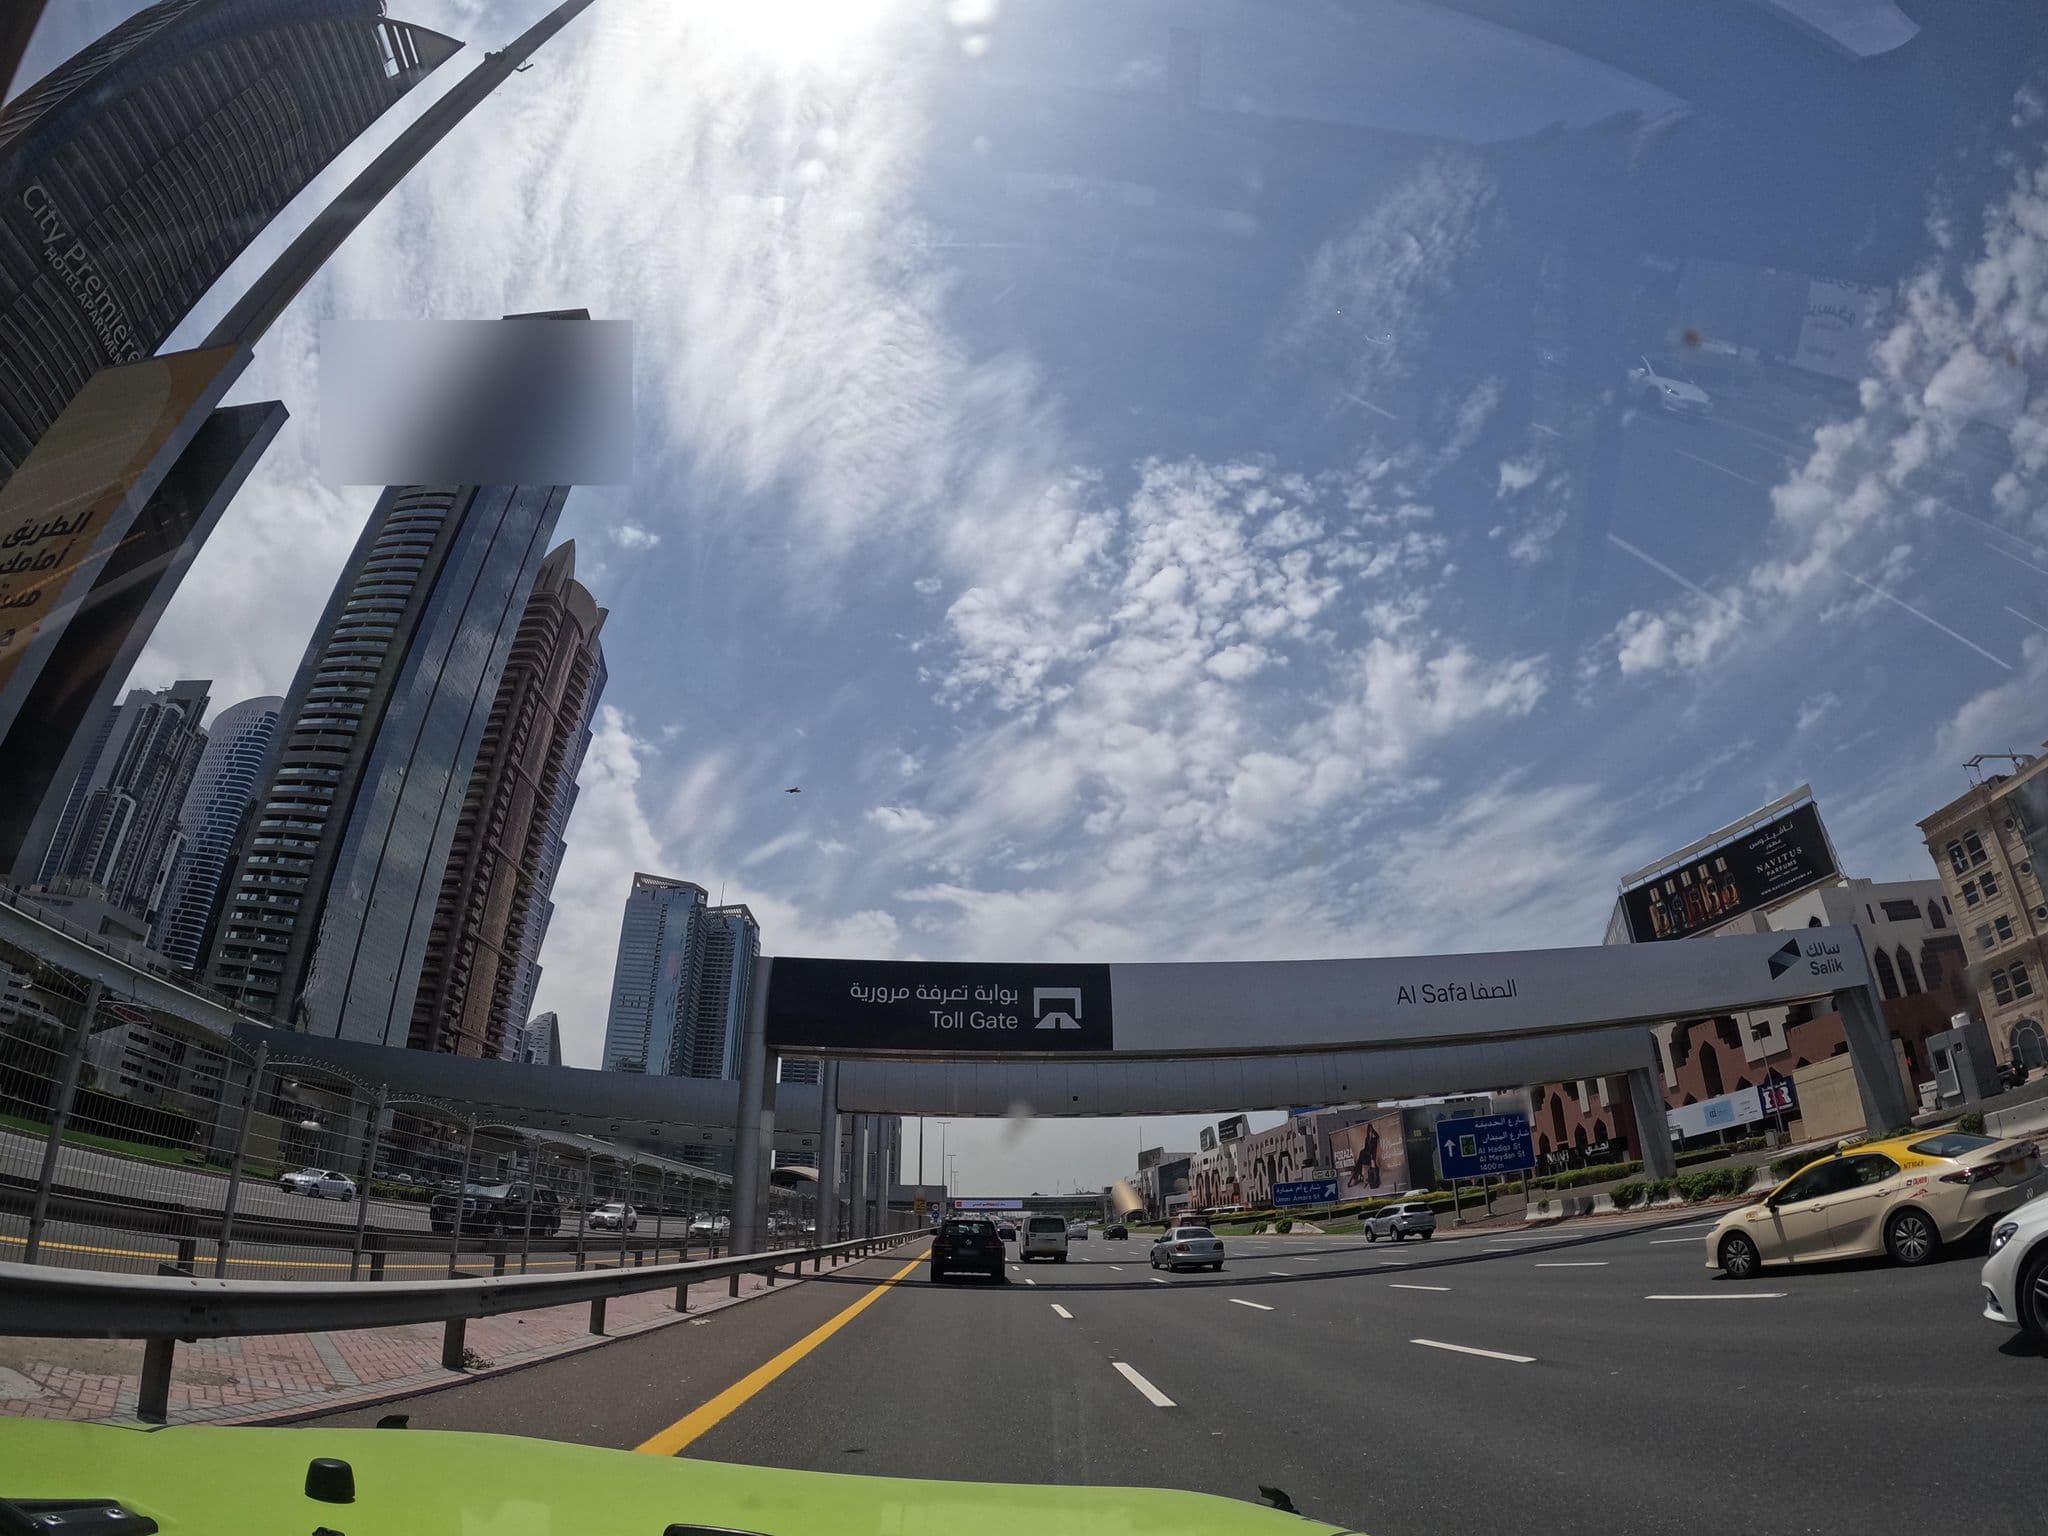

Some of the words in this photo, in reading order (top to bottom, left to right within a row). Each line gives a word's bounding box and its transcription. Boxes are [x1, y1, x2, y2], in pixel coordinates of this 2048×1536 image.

[24, 185, 67, 244] City
[44, 246, 82, 293] HOTEL
[77, 292, 124, 364] APARTMEN
[2, 511, 94, 548] الطريق
[1755, 846, 1802, 874] NAVITUS
[1766, 859, 1797, 876] PARFUMS
[1806, 941, 1841, 958] سالك
[1810, 958, 1844, 976] Salik
[850, 982, 910, 1004] مرورية
[916, 984, 968, 1005] تعرفة
[974, 983, 1018, 1005] بوابة
[1397, 985, 1417, 1005] Al
[1422, 982, 1467, 1003] Safa
[1470, 978, 1518, 1000] الصفا
[929, 1010, 963, 1029] Toll
[969, 1010, 1018, 1029] Gate
[1507, 1115, 1526, 1128] ارع
[1509, 1129, 1530, 1142] شارع
[1478, 1147, 1487, 1155] Al
[1512, 1142, 1521, 1151] St
[1479, 1155, 1487, 1163] Al
[1517, 1150, 1525, 1160] St
[1325, 1170, 1336, 1178] 49
[1480, 1162, 1497, 1171] 1400
